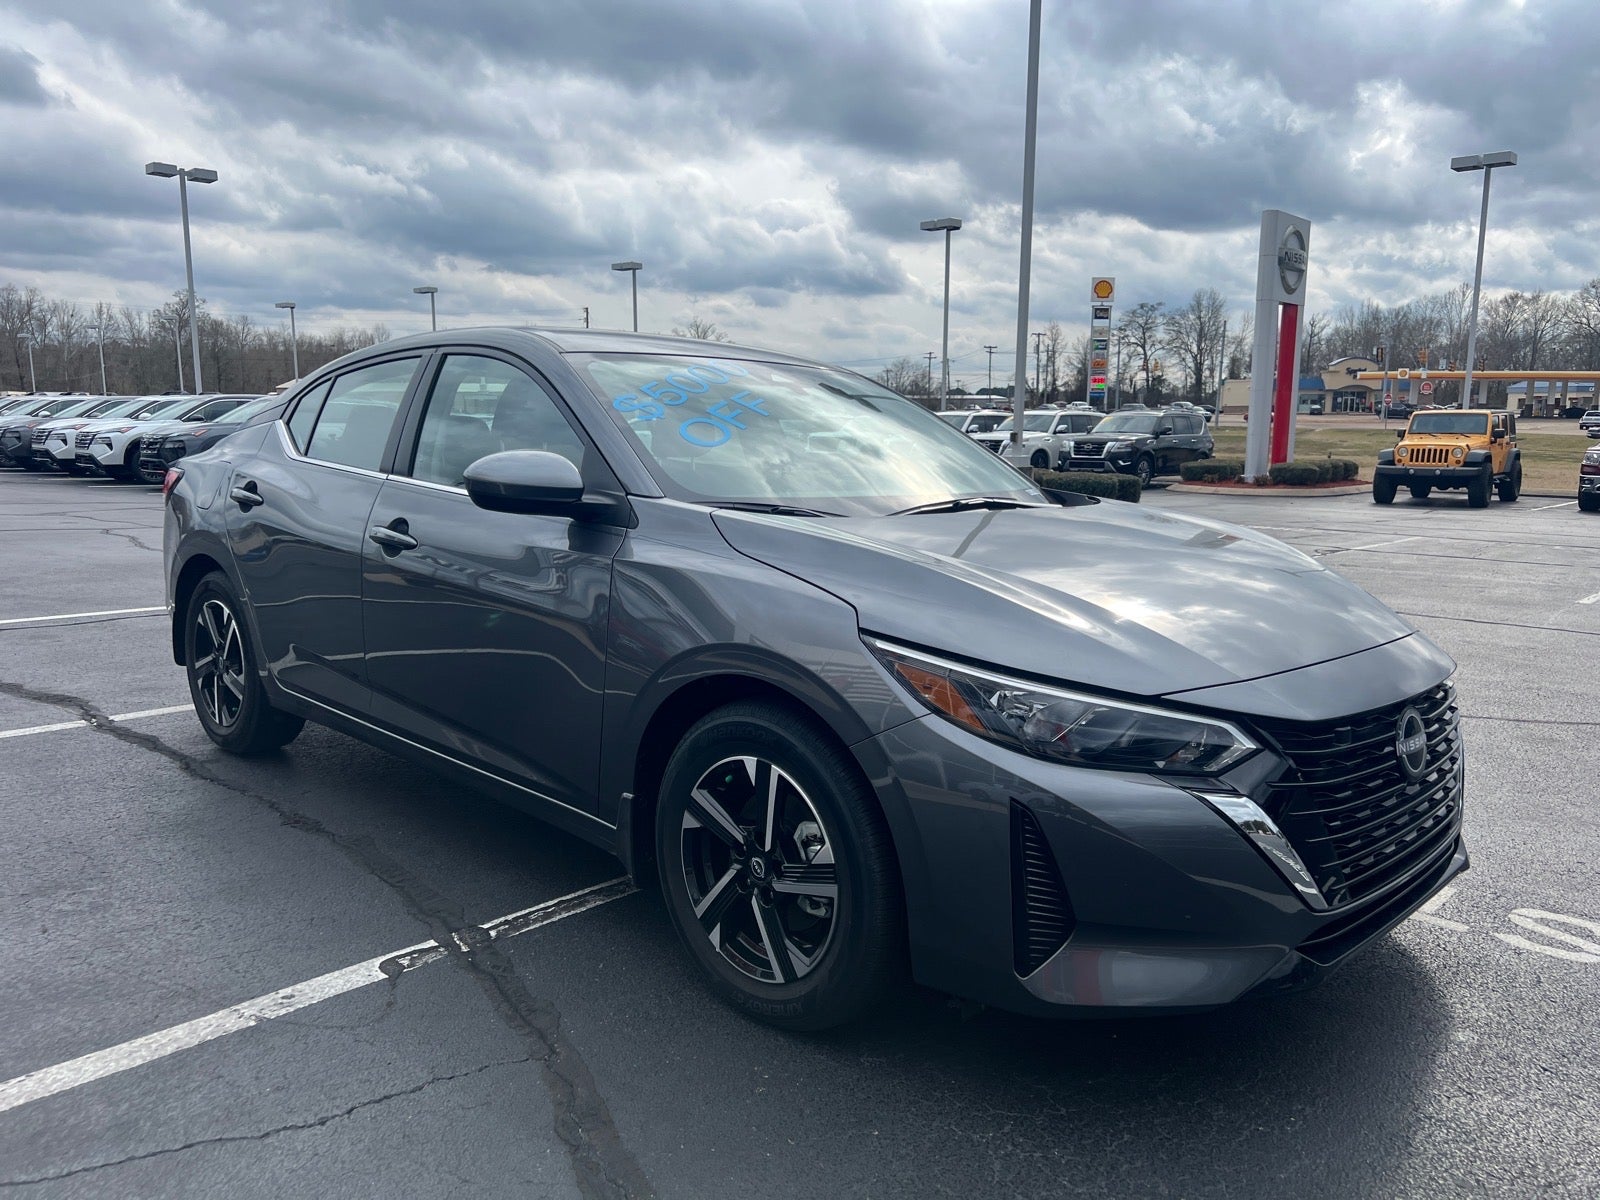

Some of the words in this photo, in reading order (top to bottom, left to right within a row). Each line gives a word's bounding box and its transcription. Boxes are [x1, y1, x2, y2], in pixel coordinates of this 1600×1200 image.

[1284, 251, 1305, 264] NISS
[613, 361, 748, 421] $5000
[679, 390, 770, 447] OFF
[1399, 735, 1424, 754] NISS
